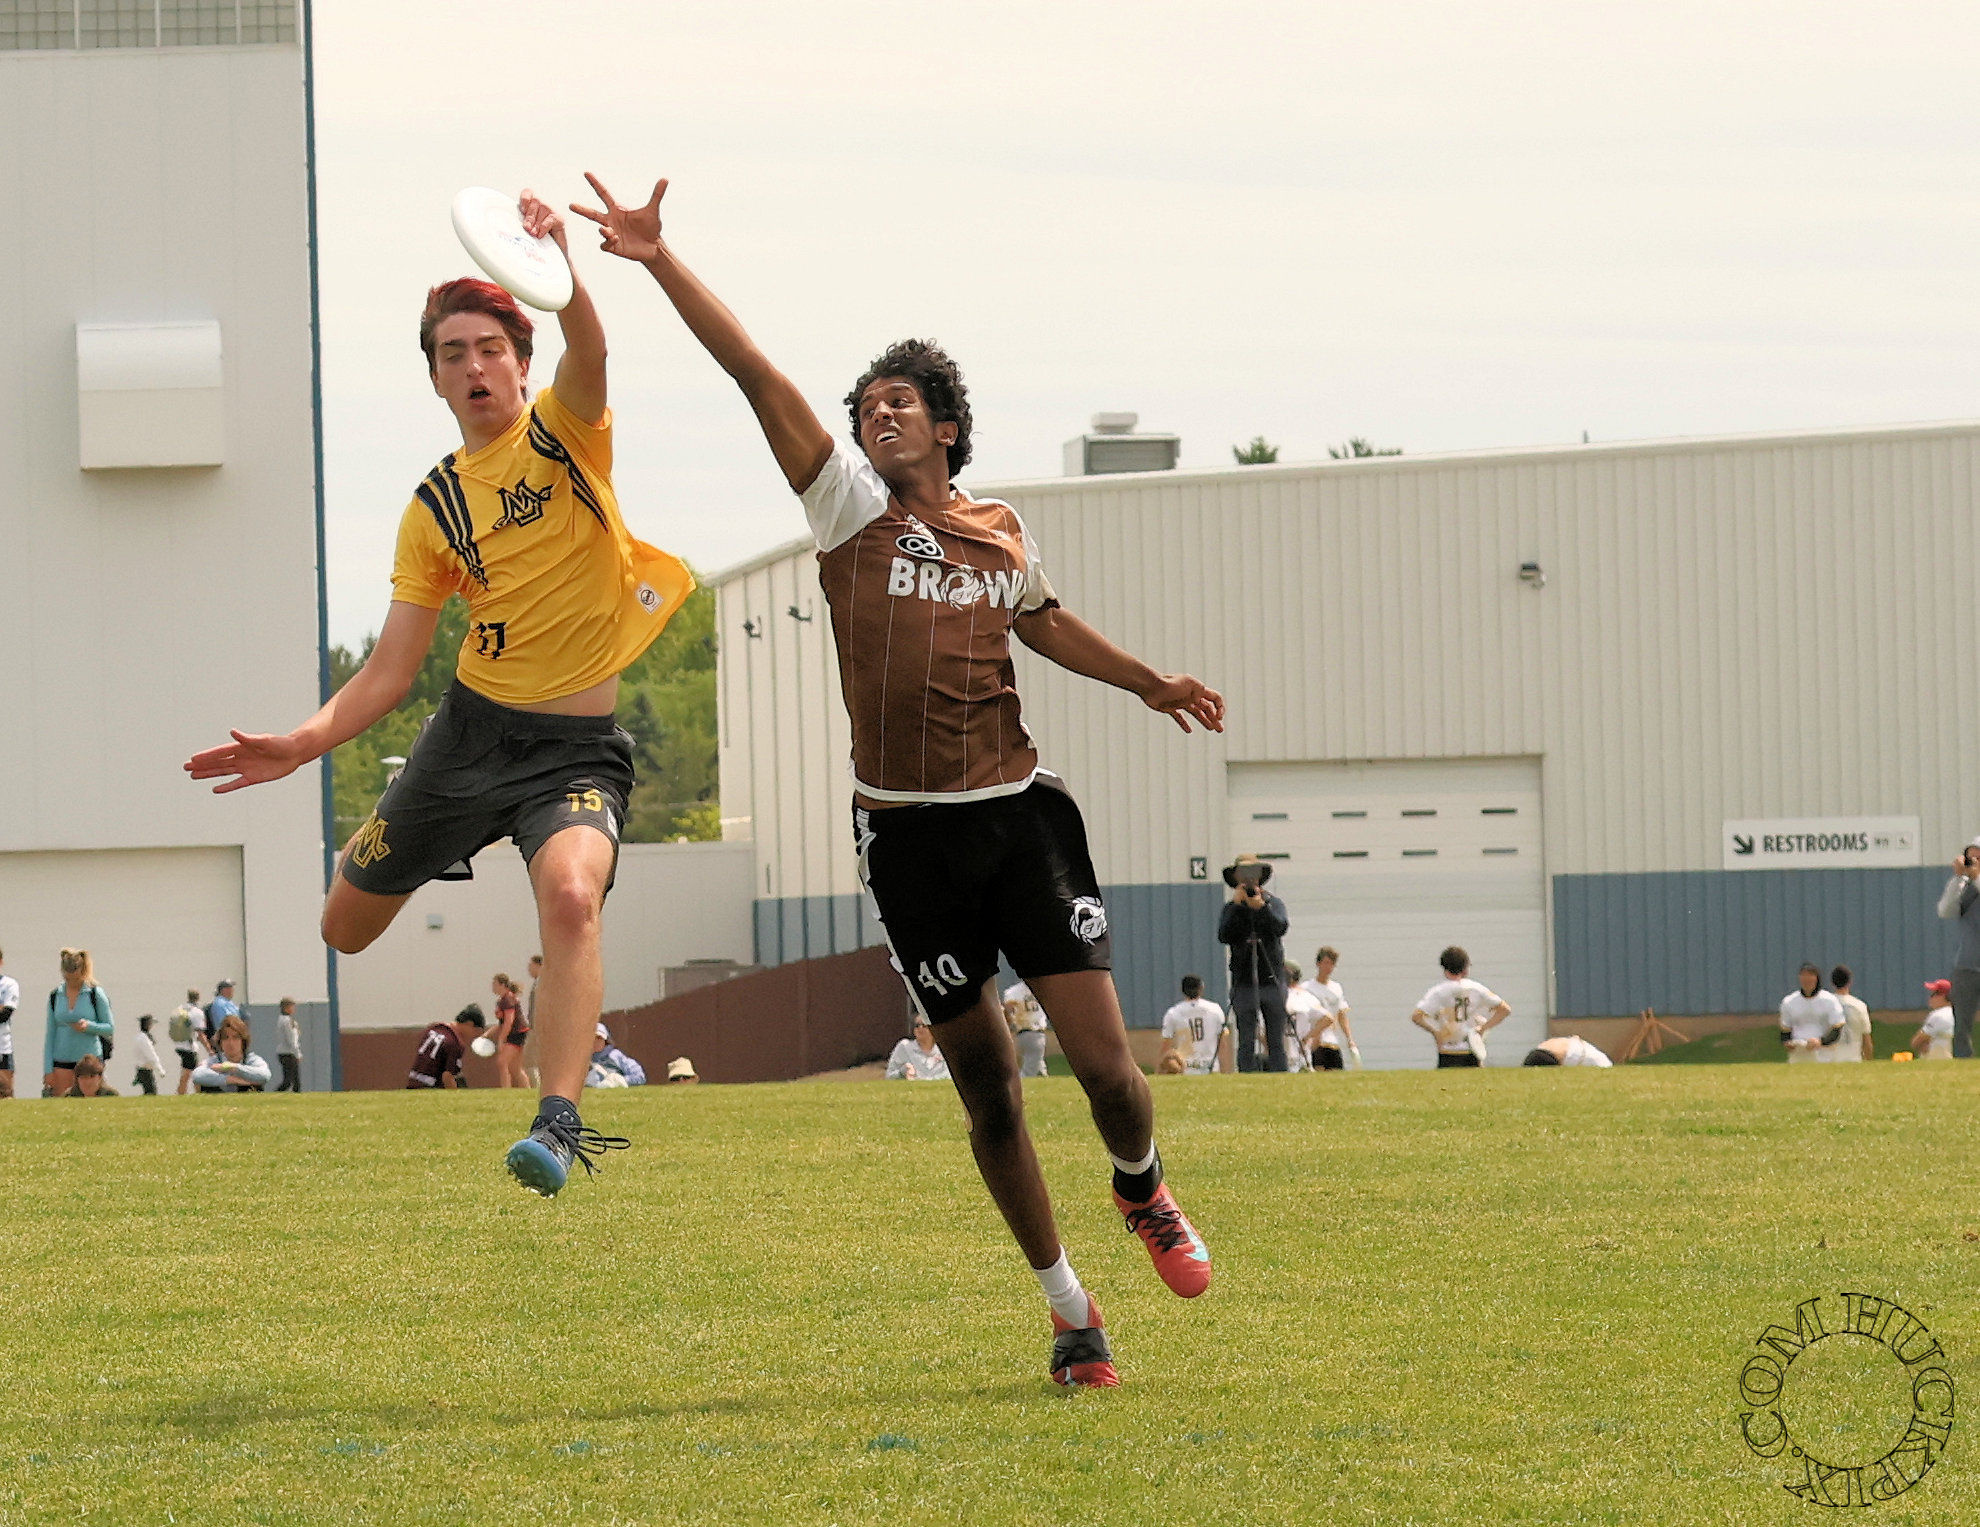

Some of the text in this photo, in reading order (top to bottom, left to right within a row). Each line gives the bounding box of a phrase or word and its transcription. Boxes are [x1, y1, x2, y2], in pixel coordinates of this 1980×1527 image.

[1763, 832, 1869, 852] RESTROOMS
[1192, 859, 1206, 877] K
[918, 953, 968, 996] 40
